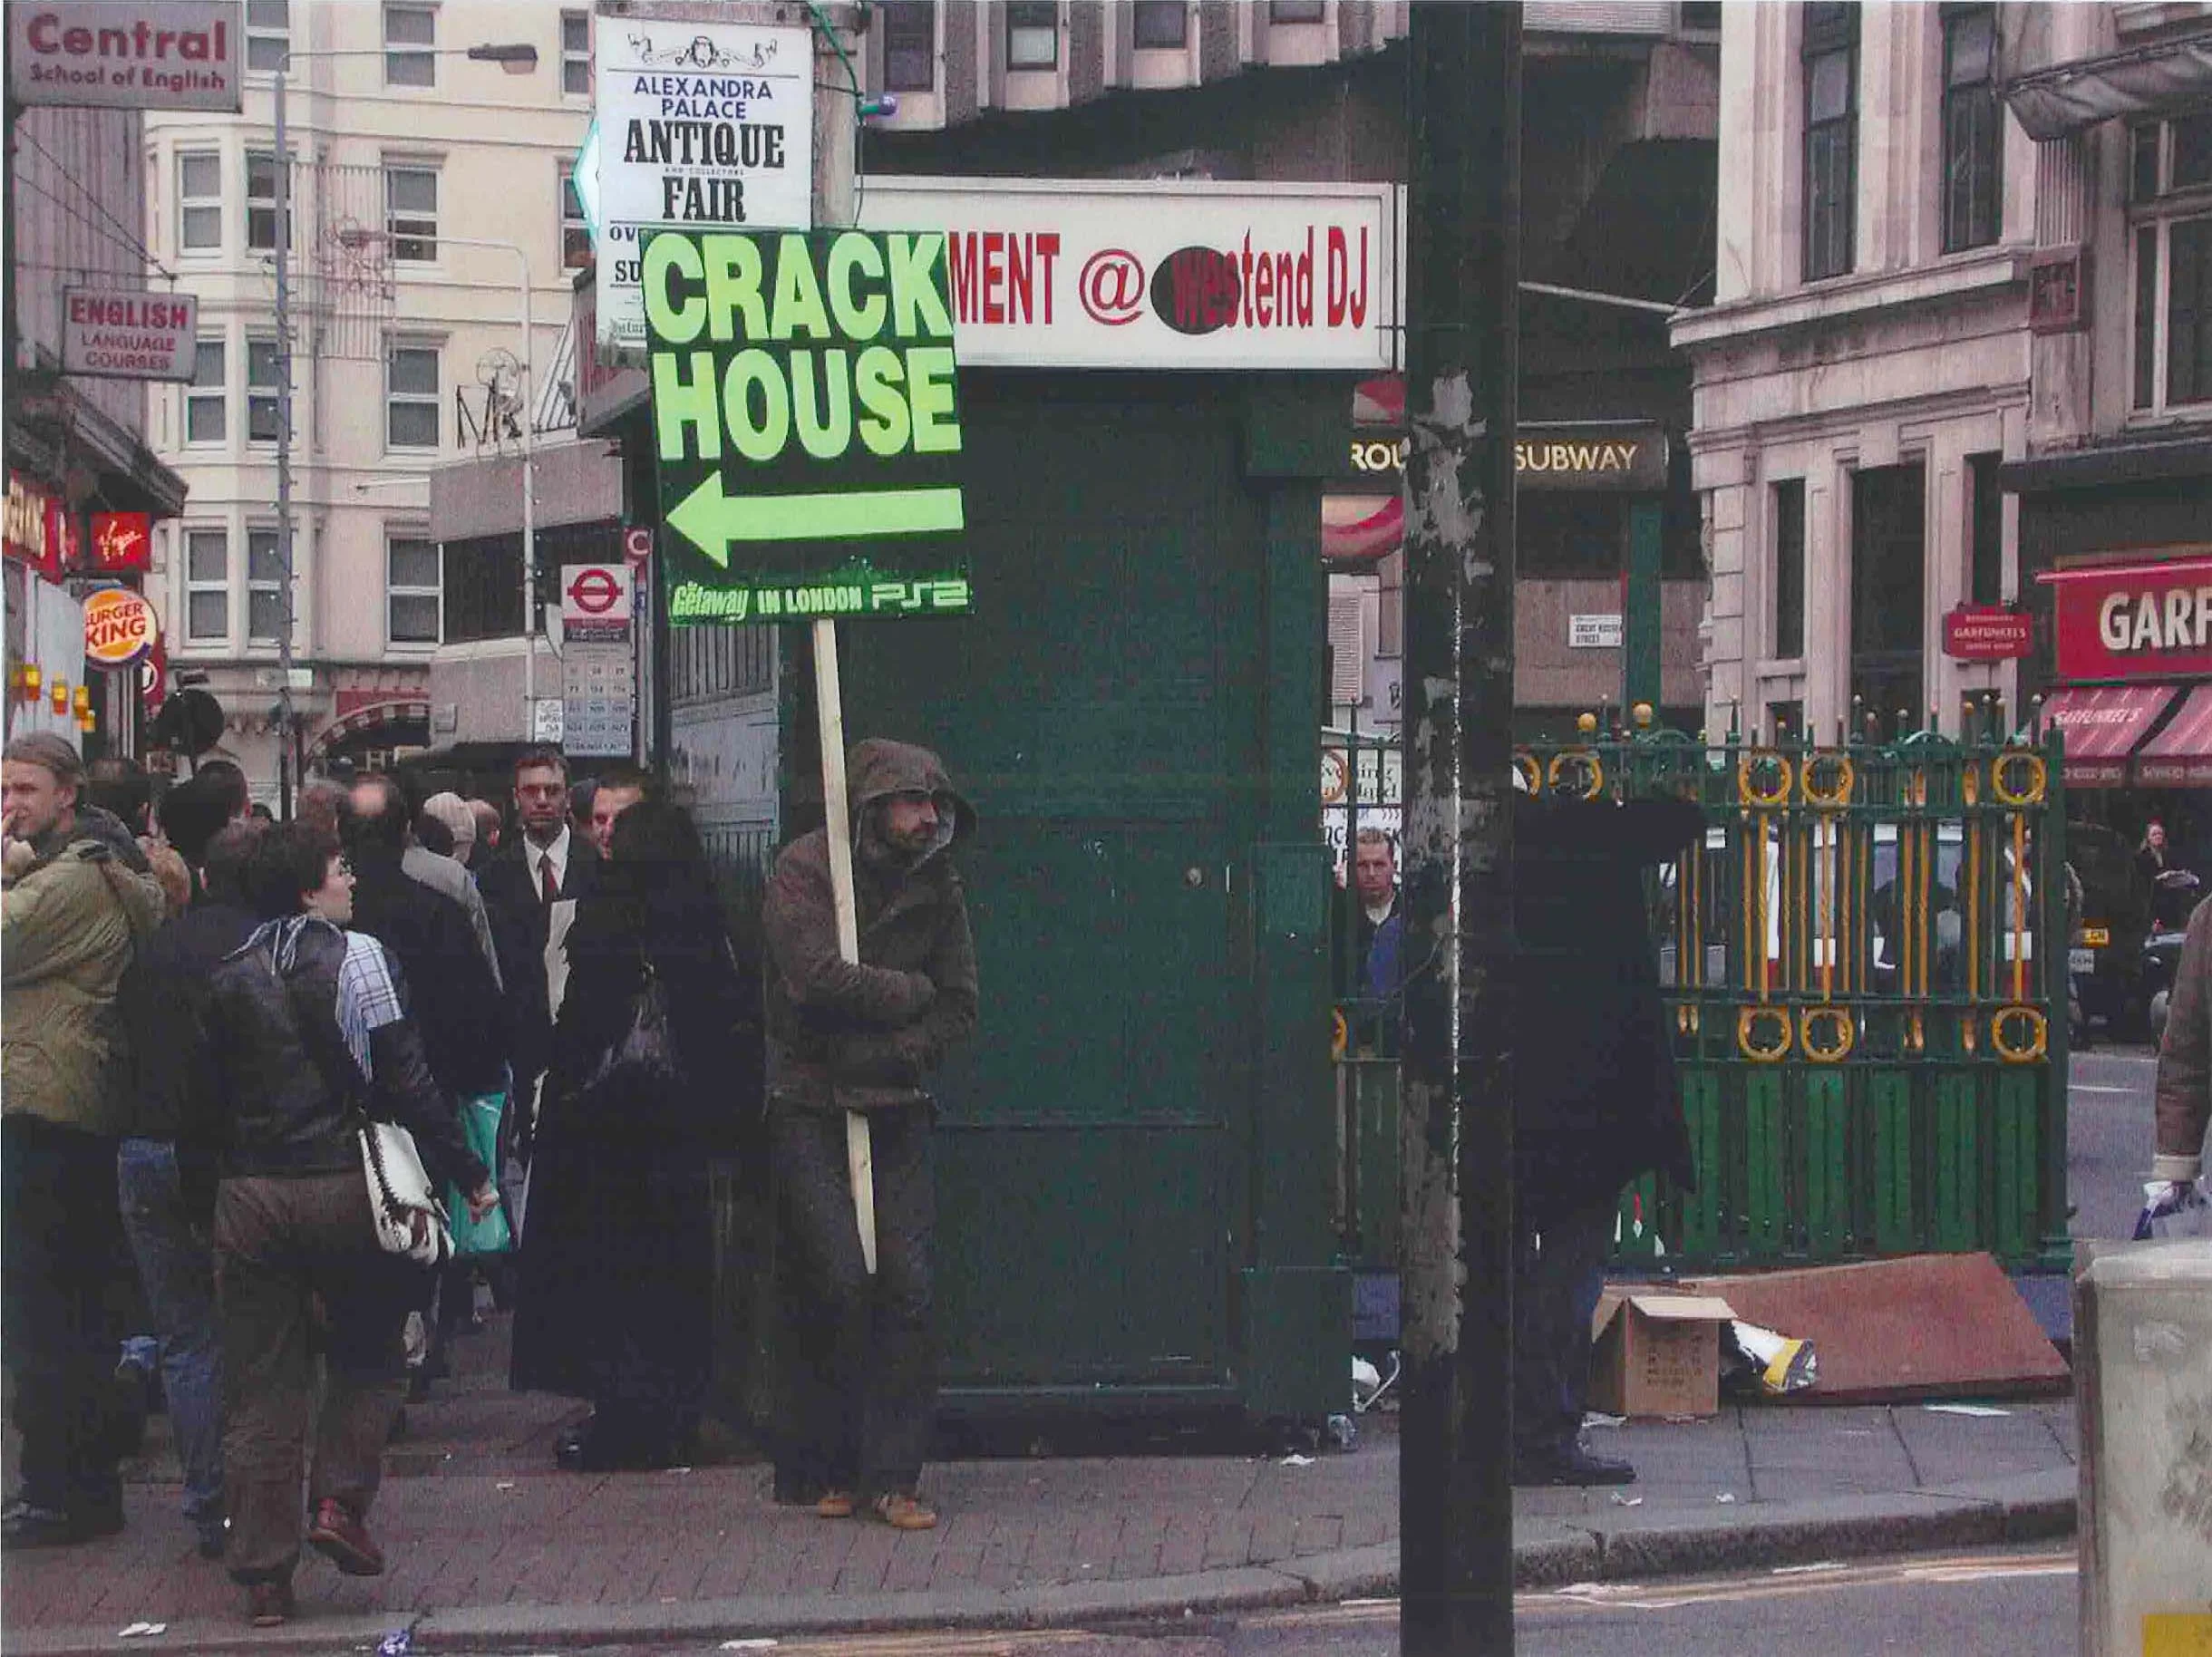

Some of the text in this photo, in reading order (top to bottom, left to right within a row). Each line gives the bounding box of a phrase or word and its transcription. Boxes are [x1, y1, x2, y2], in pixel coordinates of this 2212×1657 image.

[27, 13, 227, 60] Central
[30, 63, 226, 92] School of English
[634, 76, 773, 100] ALEXANDRA
[661, 98, 746, 120] PALACE
[624, 119, 785, 169] ANTIQUE
[662, 176, 746, 223] FAIR
[643, 232, 954, 344] CRACK
[948, 231, 1061, 325] MENT
[1079, 248, 1146, 326] @
[1327, 225, 1369, 329] DJ
[71, 297, 189, 330] ENGLISH
[82, 330, 176, 353] LANGUAGE
[85, 351, 170, 372] COURSES
[653, 346, 962, 461] HOUSE
[1515, 443, 1638, 470] SUBWAY
[757, 590, 781, 615] IN
[786, 586, 862, 613] LONDON
[871, 580, 968, 609] PS2
[86, 616, 146, 646] KING
[2100, 586, 2212, 650] GARF
